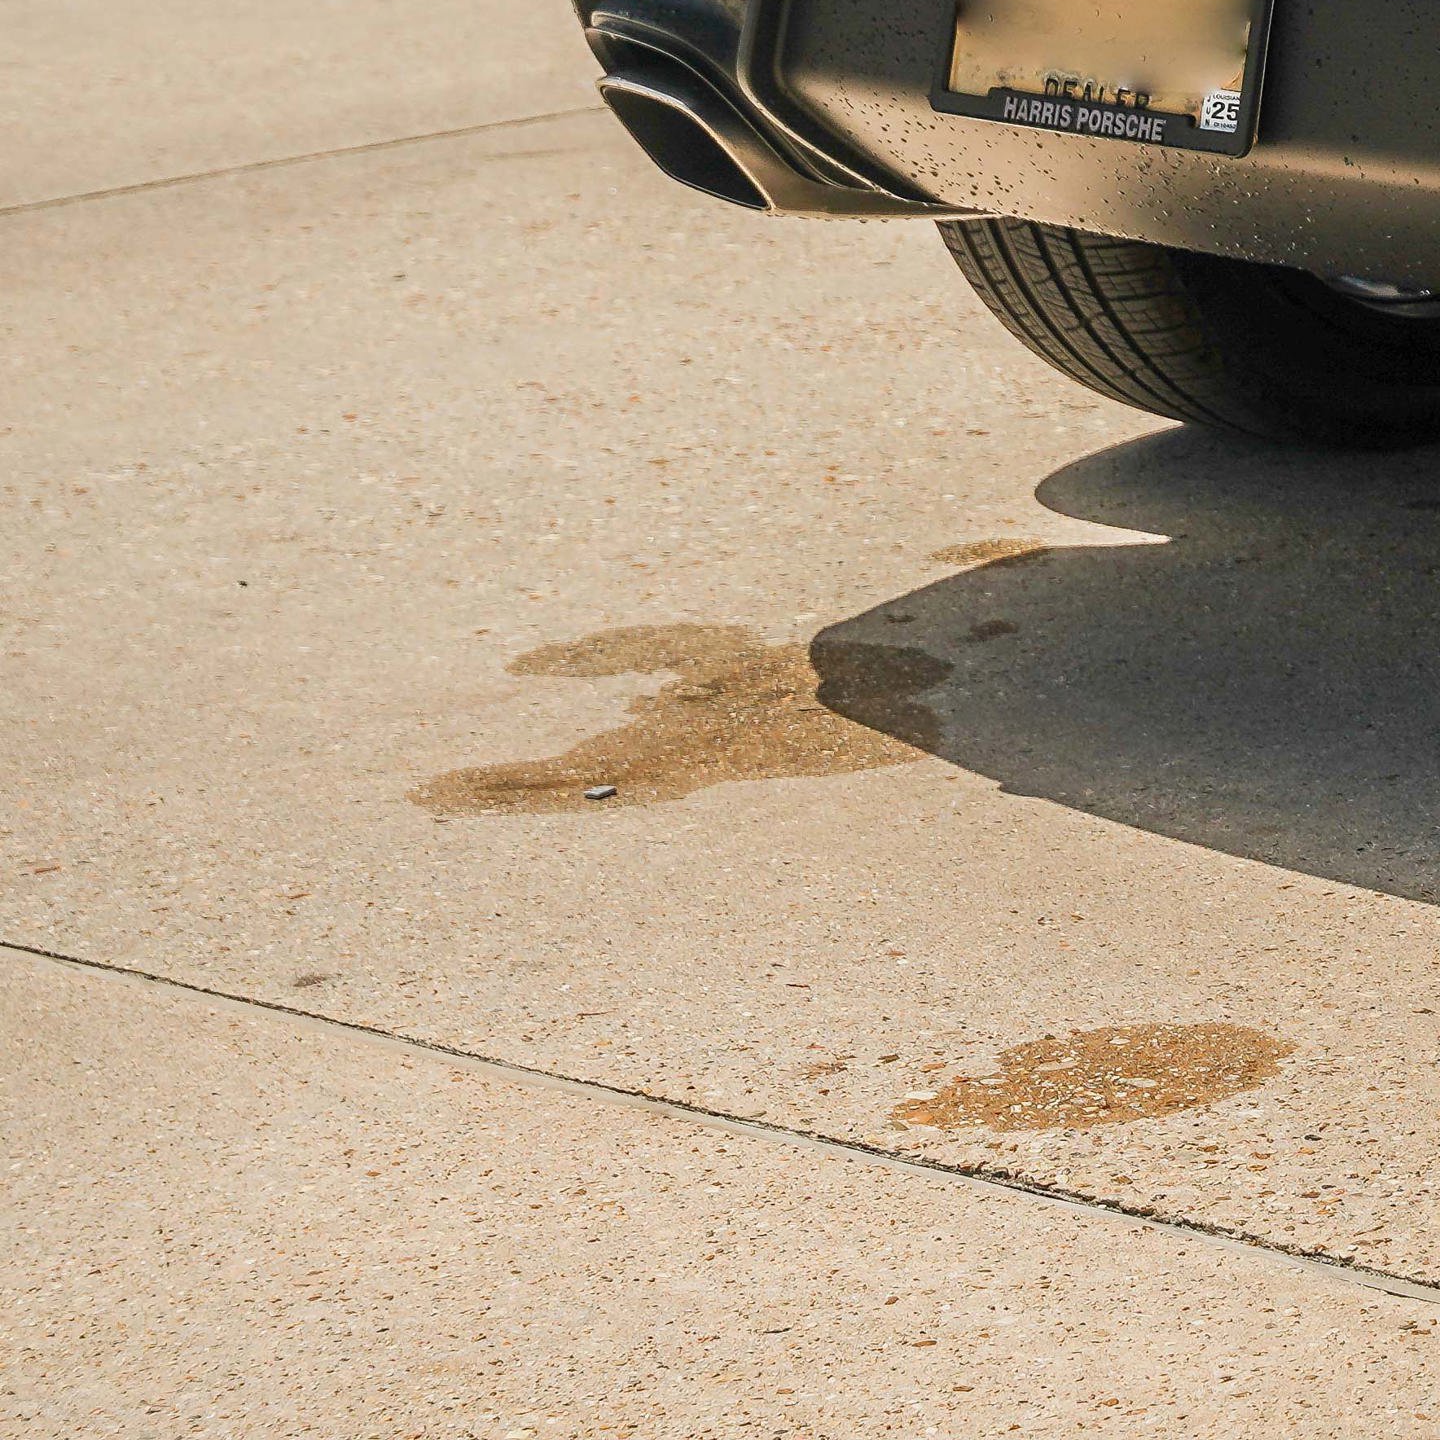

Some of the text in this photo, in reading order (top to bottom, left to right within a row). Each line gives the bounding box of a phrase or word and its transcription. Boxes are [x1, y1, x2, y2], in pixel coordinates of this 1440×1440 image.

[1003, 96, 1164, 141] HARRIS PORSCHE
[1211, 101, 1240, 121] 25
